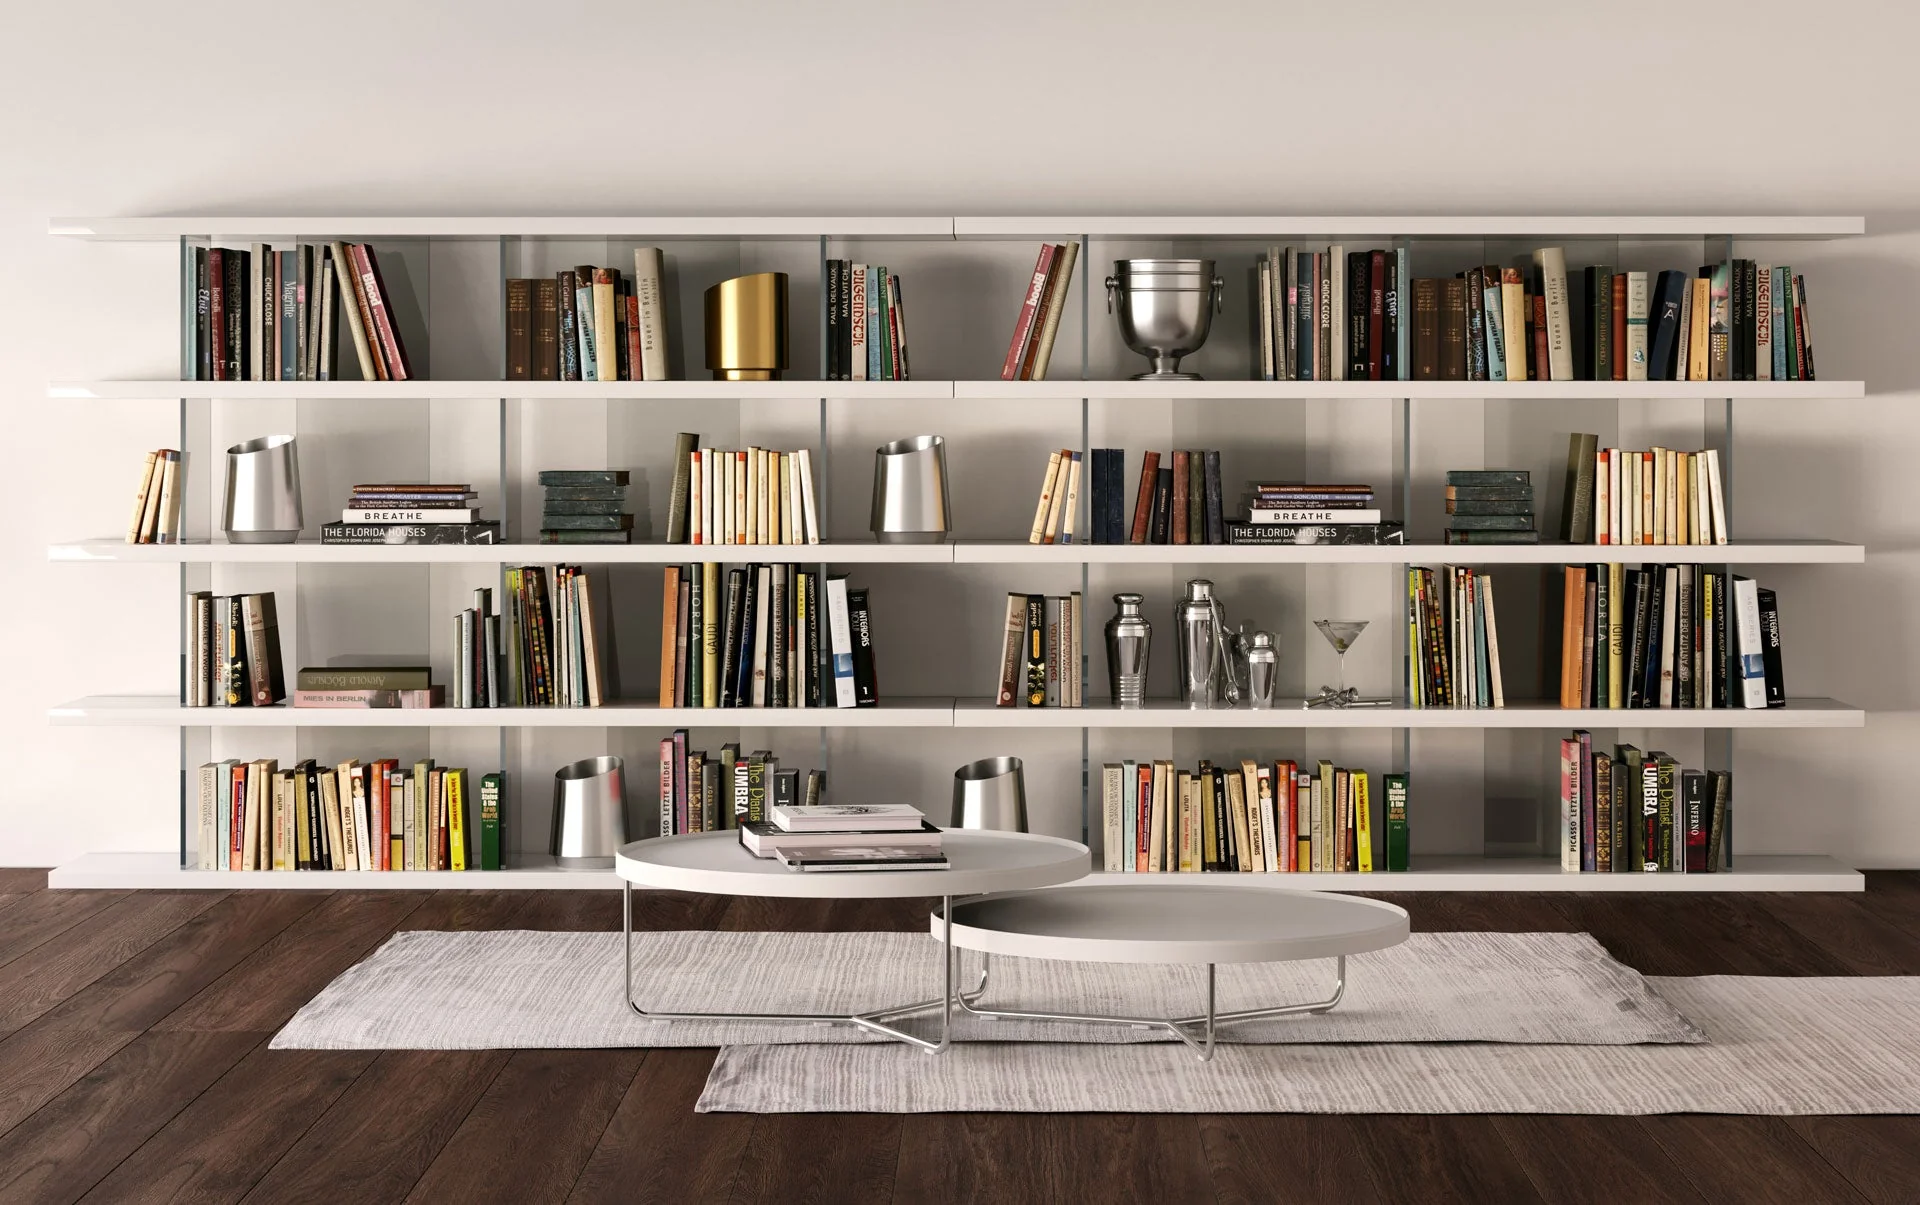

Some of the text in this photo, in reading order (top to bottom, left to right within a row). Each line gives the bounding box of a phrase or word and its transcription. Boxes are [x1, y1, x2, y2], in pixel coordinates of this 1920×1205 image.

[199, 289, 209, 314] Elvis
[212, 288, 220, 312] Botticelli
[282, 281, 296, 318] Magritte
[362, 273, 381, 306] Blood
[640, 278, 650, 306] Berlin
[1550, 278, 1559, 305] Berlin
[264, 302, 272, 326] CLOSE
[643, 310, 650, 318] in
[853, 269, 864, 347] JUGENDSTIL
[1552, 311, 1559, 319] in
[1758, 269, 1770, 346] JUGENDSTIL
[585, 337, 596, 363] FRANZEN
[1486, 310, 1504, 363] JONATHAN FRANZEN
[324, 528, 426, 537] THE FLORIDA HOUSES
[1234, 528, 1336, 537] THE FLORIDA HOUSES
[692, 585, 701, 641] HORTA
[1598, 585, 1607, 641] HORTA
[860, 610, 870, 647] INTERIORS
[1768, 611, 1779, 648] INTERIORS
[350, 676, 386, 687] ARNOLD
[863, 686, 868, 695] 1
[1772, 687, 1778, 695] 1
[750, 763, 764, 784] The
[734, 766, 748, 815] UMBRA
[1643, 767, 1657, 816] UMBRA
[1659, 763, 1674, 825] The Pianist
[1689, 800, 1700, 836] INFERNO
